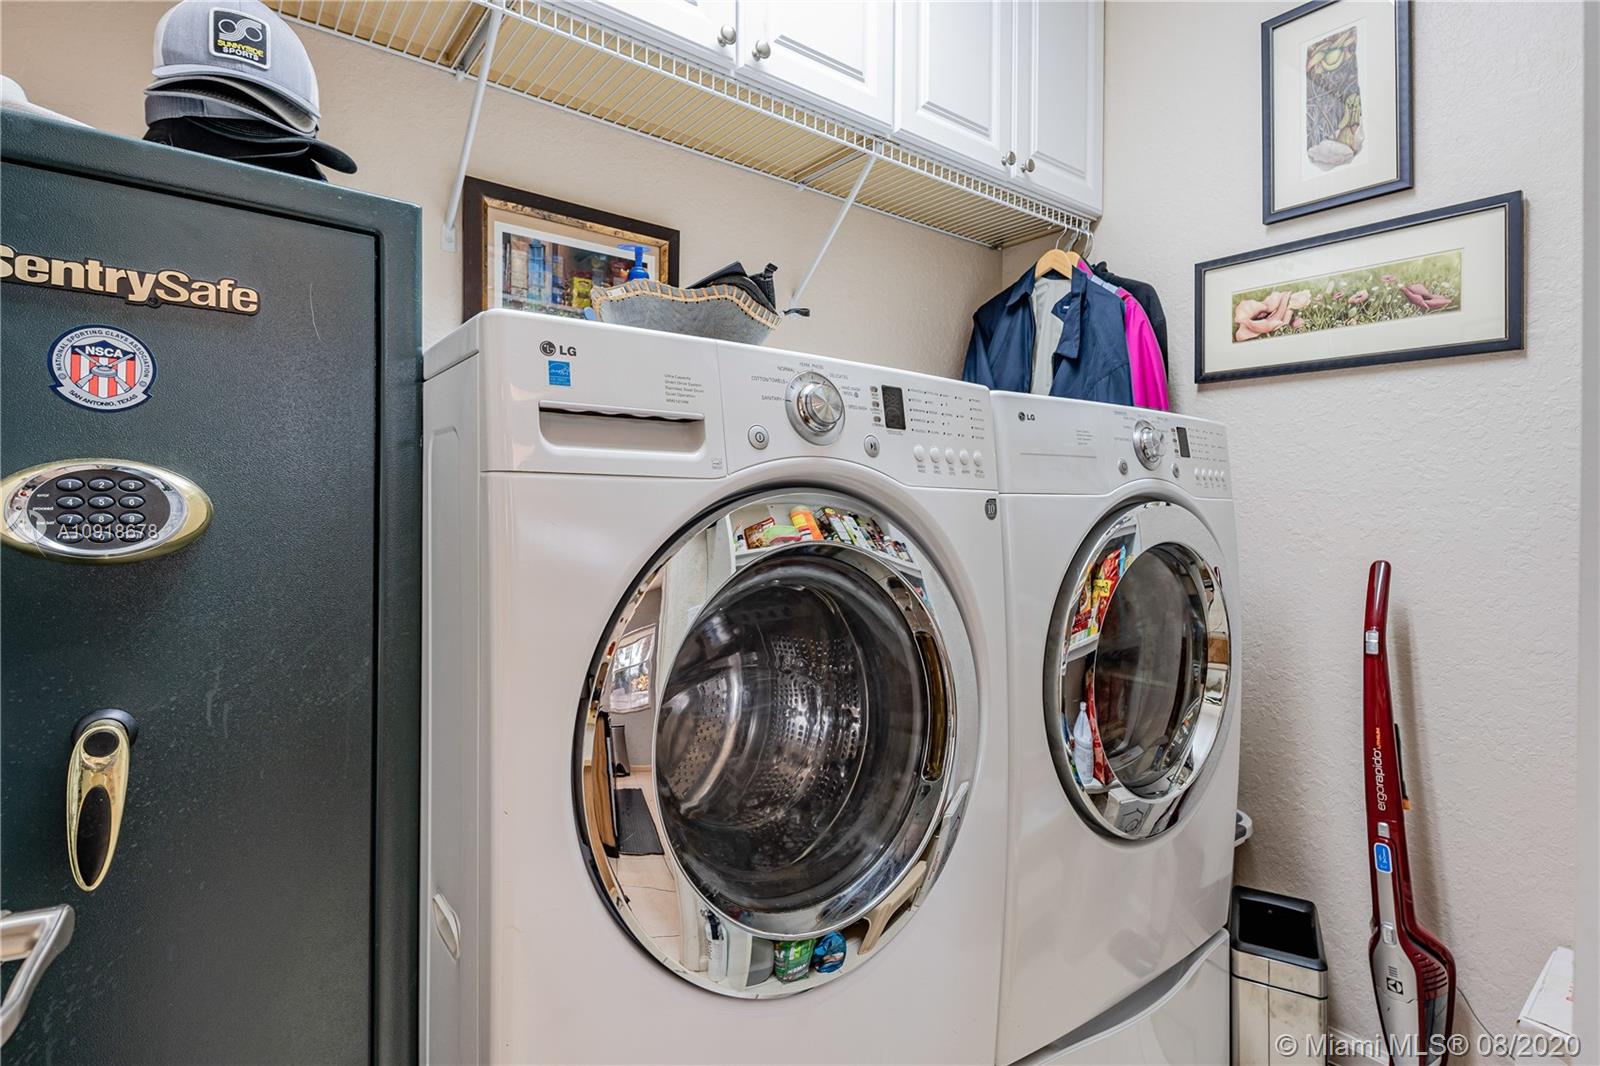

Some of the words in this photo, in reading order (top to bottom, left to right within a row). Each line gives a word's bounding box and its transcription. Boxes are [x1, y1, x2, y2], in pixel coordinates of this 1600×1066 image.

[217, 39, 264, 57] SUNNYSIDE
[222, 46, 259, 61] SPORTS
[55, 342, 68, 371] NATIONAL
[67, 329, 103, 343] SPORTING
[105, 330, 129, 342] CLAYS
[128, 341, 150, 378] ASSOCIATION
[85, 345, 124, 359] NSCA
[559, 345, 577, 357] LG
[69, 389, 83, 401] SAN
[117, 393, 138, 406] TEXAS
[1372, 750, 1387, 811] ergorapido
